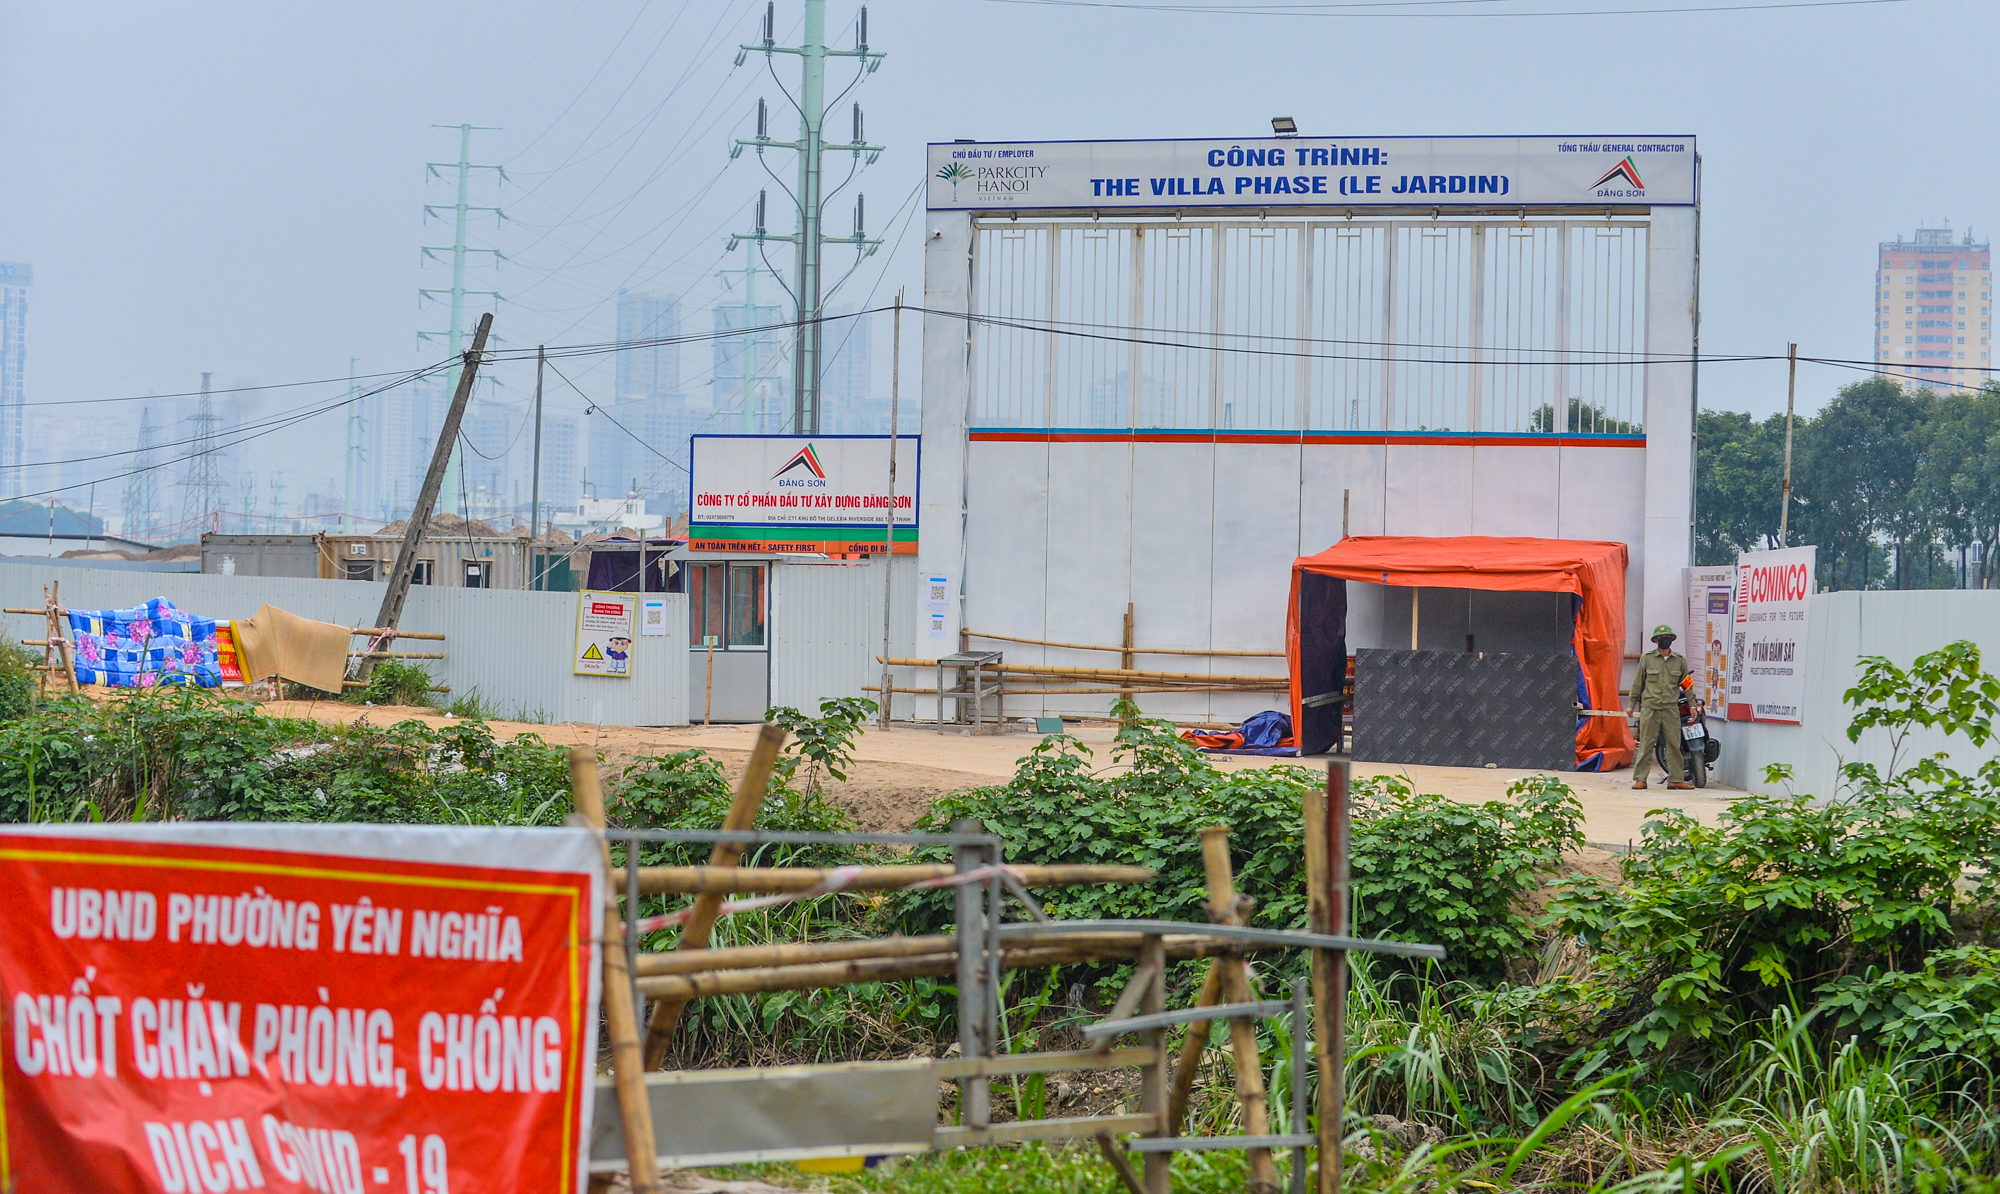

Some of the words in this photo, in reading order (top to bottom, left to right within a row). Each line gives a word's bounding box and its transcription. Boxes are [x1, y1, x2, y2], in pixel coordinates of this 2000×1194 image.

[998, 150, 1034, 158] EMPLOYER
[1602, 144, 1635, 152] GENERAL
[1637, 144, 1685, 152] CONTRACTOR
[1207, 145, 1285, 167] CÔNG
[1295, 144, 1388, 166] TRÌNH:
[978, 166, 1047, 179] PARKCITY
[977, 180, 1029, 192] HANOI
[1090, 178, 1140, 196] THE
[1150, 177, 1225, 196] VILLA
[1235, 176, 1328, 195] PHASE
[1339, 175, 1381, 196] (LE
[1392, 175, 1509, 196] JARDIN)
[1597, 189, 1624, 197] ĐĂNG
[778, 478, 805, 487] ĐĂNG
[807, 479, 826, 487] SƠN
[697, 491, 722, 506] CÔNG
[724, 494, 735, 507] TY
[737, 490, 750, 507] CỔ
[801, 494, 813, 507] TƯ
[814, 493, 832, 508] XÂY
[835, 494, 861, 510] DỰNG
[863, 493, 889, 508] ĐĂNG
[893, 495, 912, 508] SƠN
[695, 542, 705, 550] AN
[707, 541, 726, 550] TOÀN
[728, 541, 746, 550] TRÊN
[748, 541, 761, 550] HẾT
[796, 544, 816, 552] FIRST
[848, 542, 868, 552] CỔNG
[1751, 563, 1807, 603] CONINCO
[1789, 611, 1804, 621] FUTURE
[1752, 641, 1759, 662] TƯ
[1784, 638, 1795, 662] SÁT
[51, 887, 157, 940] UBND
[167, 886, 320, 951] PHƯỜNG
[331, 896, 403, 956] YÊN
[410, 906, 523, 963] NGHĨA
[13, 967, 122, 1079] CHỐT
[130, 984, 251, 1096] CHẶN
[256, 987, 407, 1099] PHÒNG,
[417, 988, 562, 1093] CHỐNG
[262, 1114, 364, 1194] COVID
[398, 1134, 448, 1194] 19
